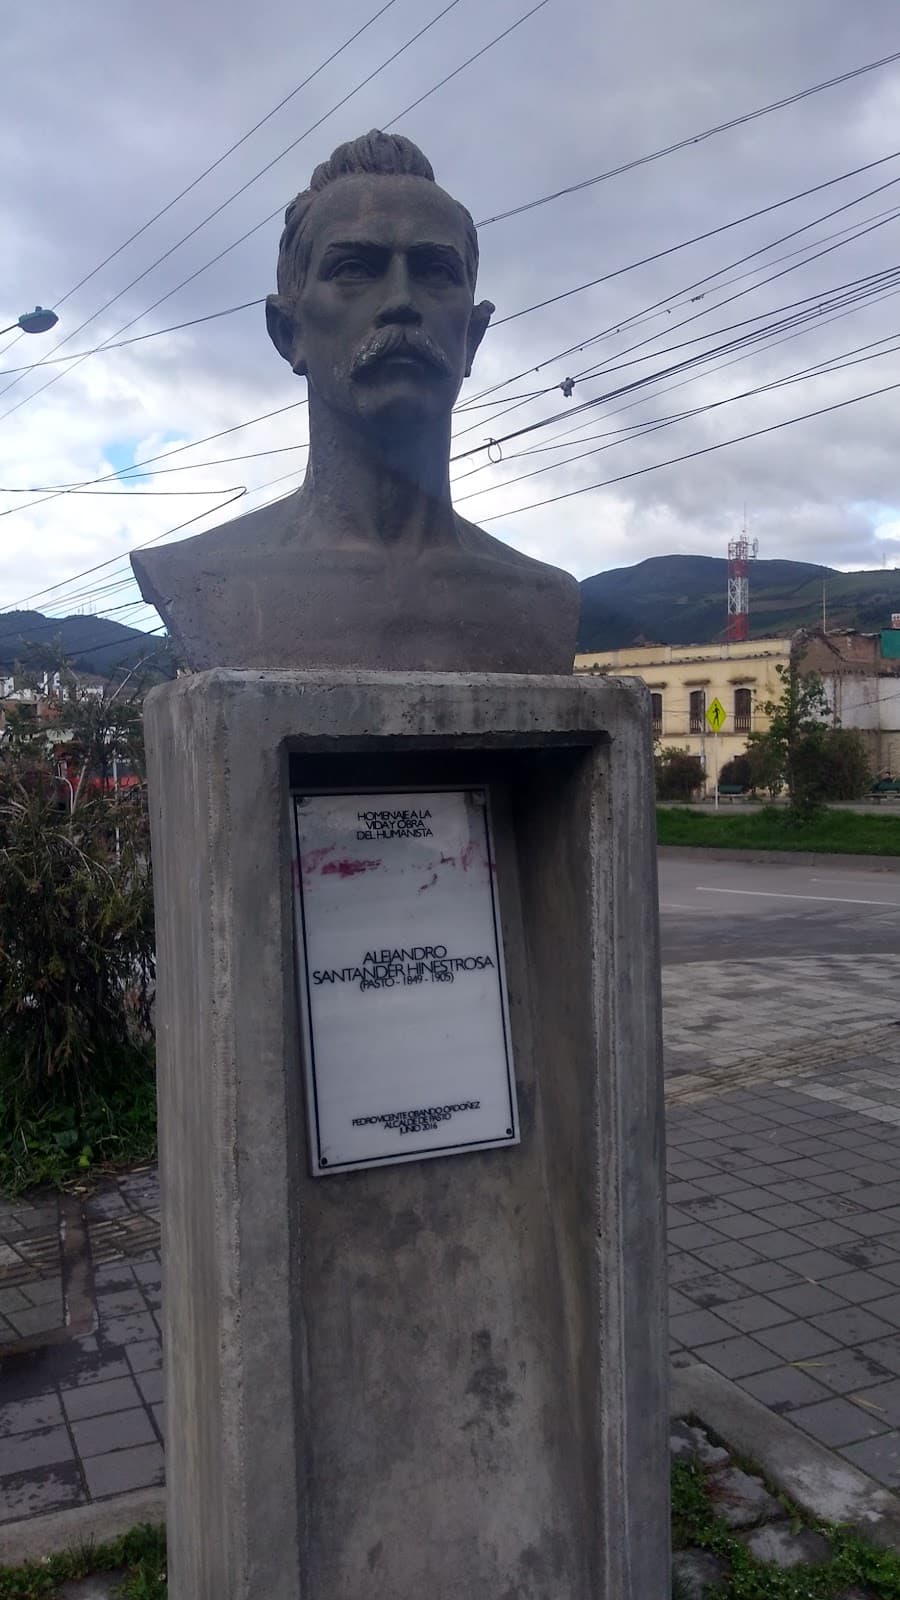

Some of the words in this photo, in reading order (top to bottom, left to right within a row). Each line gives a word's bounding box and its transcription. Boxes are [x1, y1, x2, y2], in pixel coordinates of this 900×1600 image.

[357, 810, 410, 821] HOMENAJE
[410, 810, 418, 820] A
[419, 809, 432, 819] LA
[357, 830, 376, 840] DEL
[377, 828, 433, 839] HUMANISTA
[366, 821, 389, 830] VIDA
[389, 820, 396, 829] Y
[397, 820, 425, 829] OBRA
[362, 945, 447, 965] ALEJANDRO
[312, 963, 406, 985] SANTANDER
[407, 955, 495, 975] HINESTROSA
[360, 977, 395, 992] (PASTO
[403, 974, 423, 985] 1849
[432, 971, 454, 983] 1905)
[352, 1116, 377, 1128] PEDRO
[376, 1112, 407, 1122] VICENTE
[408, 1107, 442, 1118] OBANDO
[384, 1118, 418, 1130] ALCALDE
[419, 1116, 429, 1125] DE
[430, 1112, 452, 1122] PASTO
[422, 1121, 438, 1131] 2016
